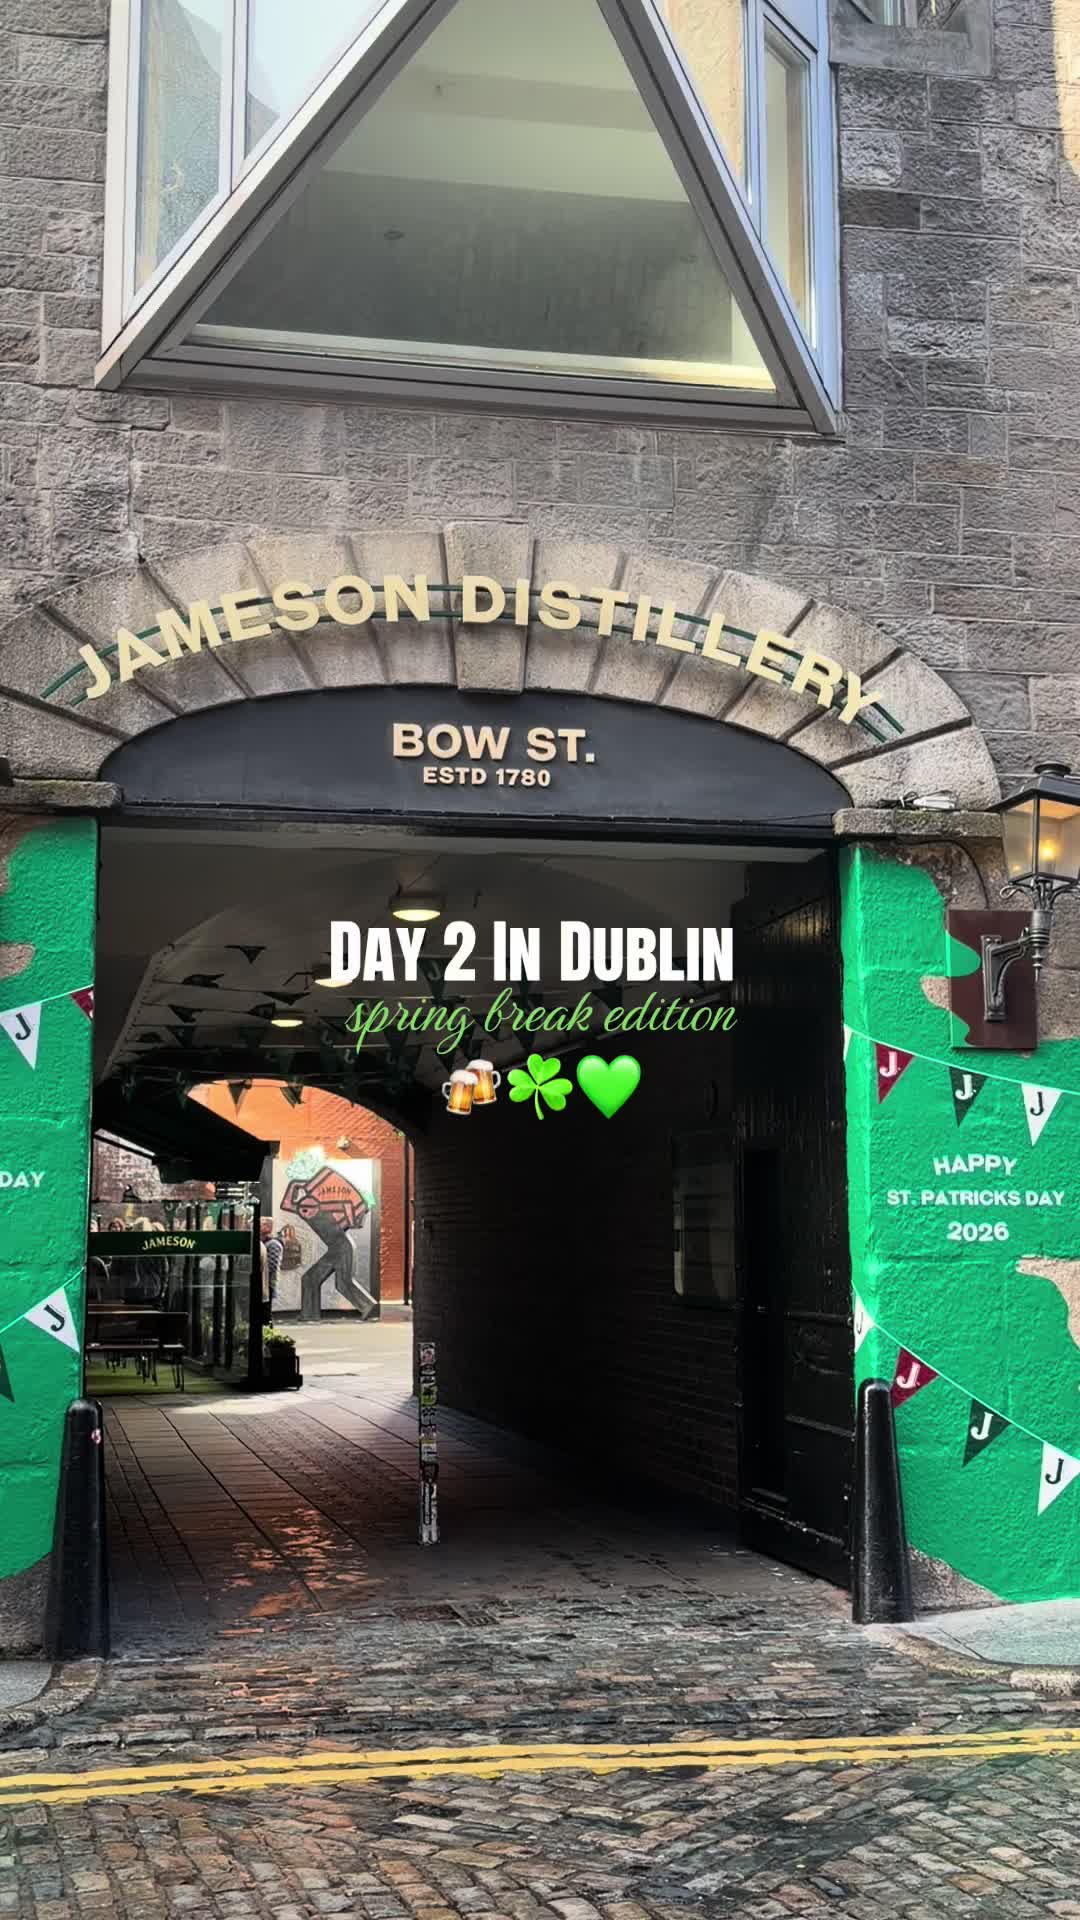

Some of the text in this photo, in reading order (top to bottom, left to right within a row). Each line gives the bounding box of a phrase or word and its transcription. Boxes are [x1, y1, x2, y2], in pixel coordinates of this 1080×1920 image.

[78, 574, 882, 726] JAMESON DISTILLERY
[392, 722, 597, 763] BOW ST.
[423, 767, 551, 788] ESTD 1780
[15, 1012, 31, 1041] J
[879, 1051, 898, 1077] J
[955, 1074, 974, 1100] J
[1030, 1091, 1045, 1116] J
[933, 1153, 1018, 1176] HAPPY
[0, 1170, 46, 1188] DAY
[887, 1189, 1065, 1207] ST. PATRICKS DAY
[142, 1235, 197, 1250] JAMESON
[947, 1221, 1009, 1242] 2026
[44, 1303, 65, 1332] J
[896, 1361, 921, 1389] J
[970, 1411, 994, 1441] J
[1045, 1457, 1064, 1485] J
